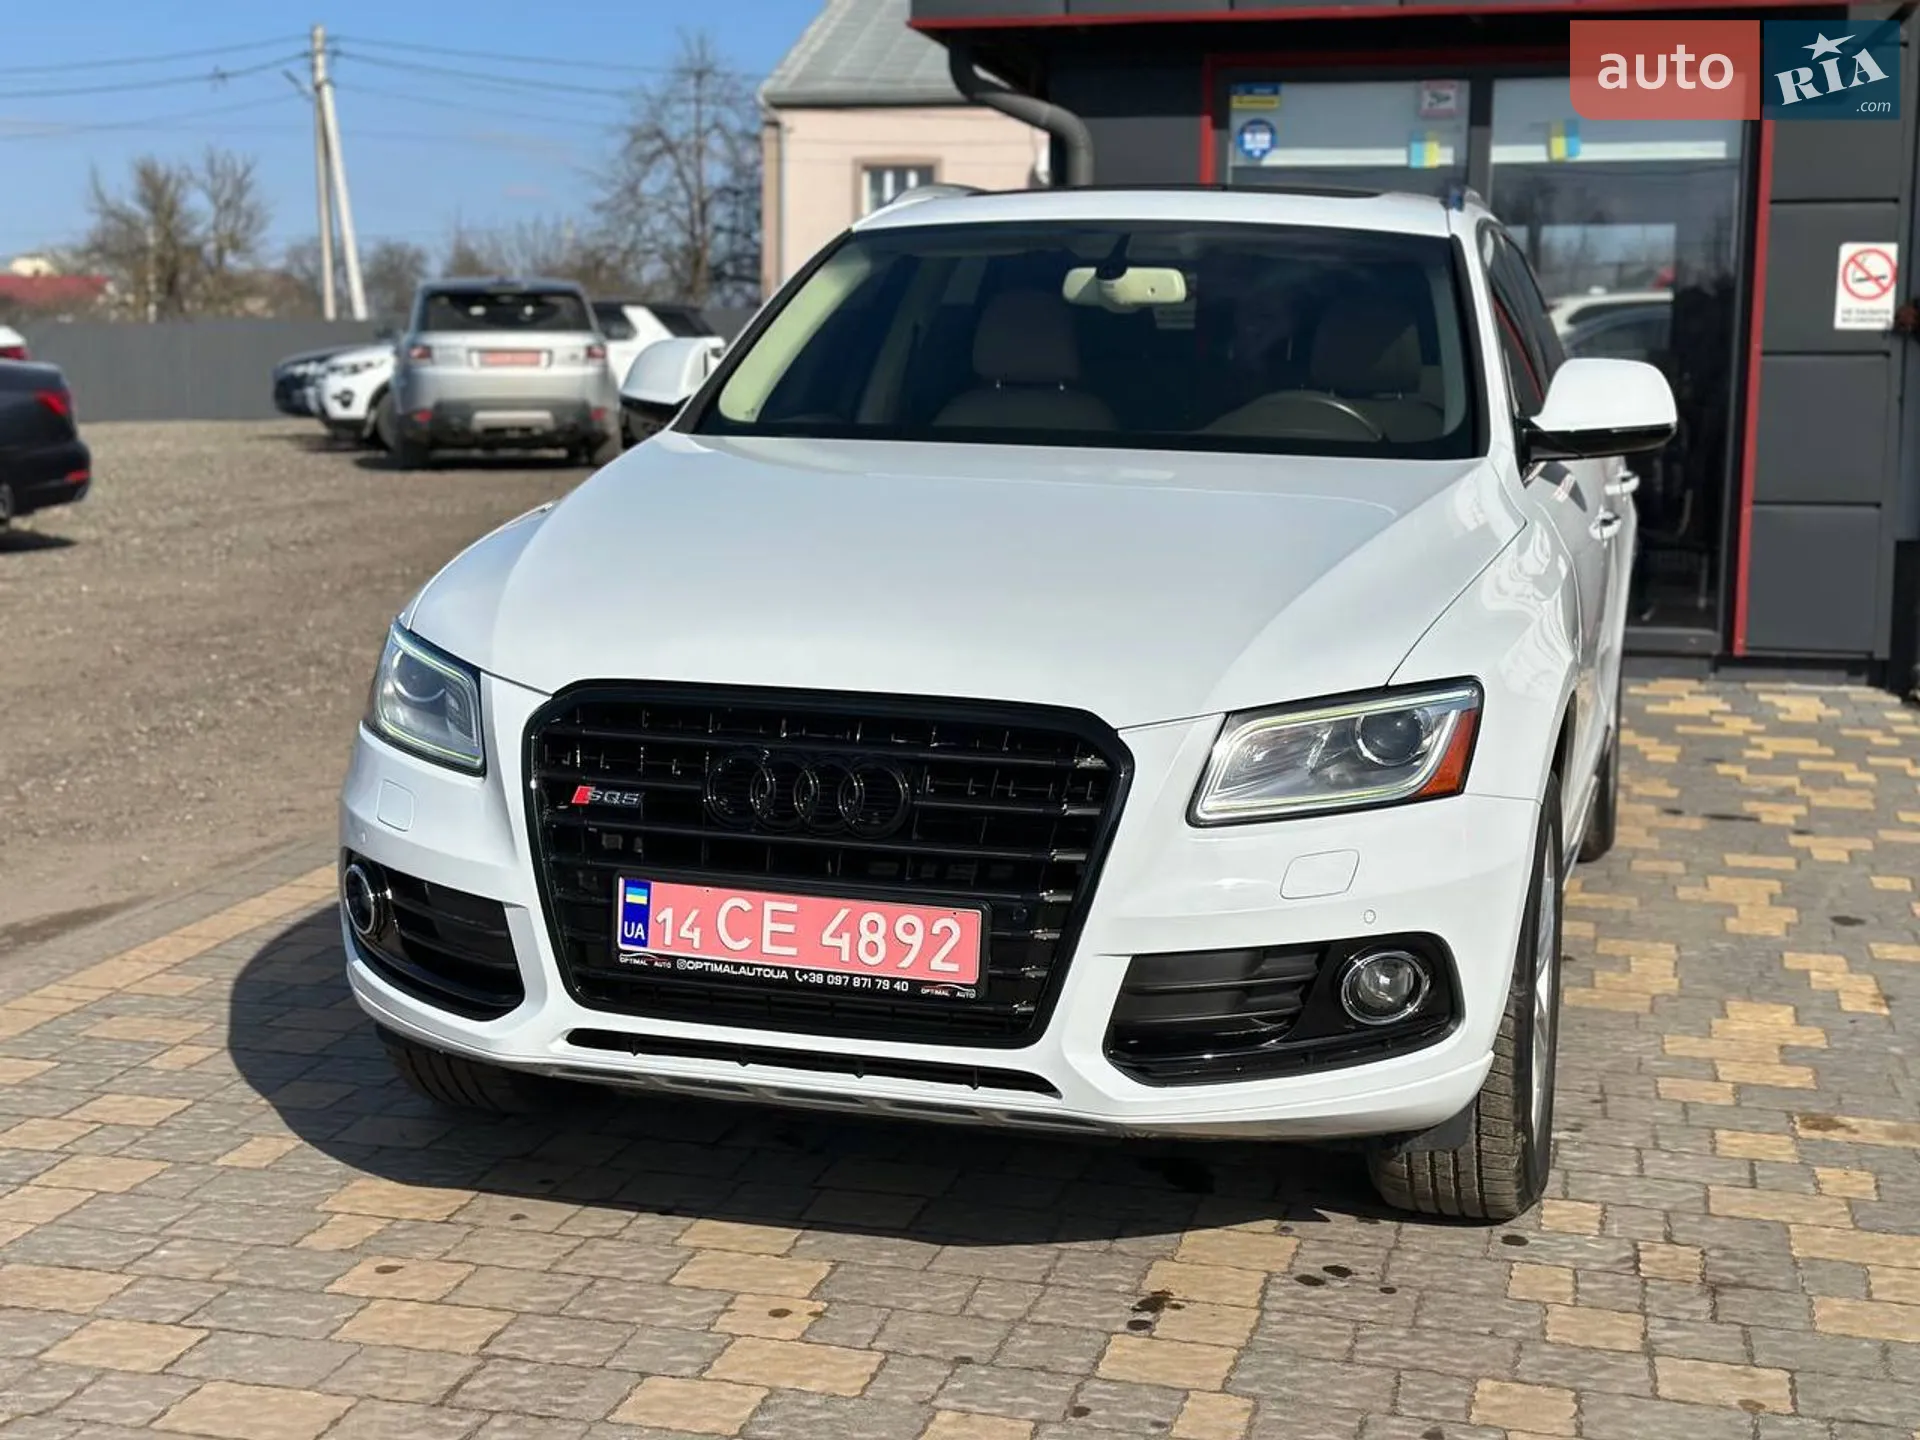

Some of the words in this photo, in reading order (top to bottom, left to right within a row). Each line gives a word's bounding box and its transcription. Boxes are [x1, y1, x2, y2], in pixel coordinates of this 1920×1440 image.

[624, 920, 645, 941] UA
[655, 906, 701, 949] 14
[716, 897, 798, 956] CE
[820, 907, 961, 973] 4892
[619, 957, 648, 966] OPTIMAL
[653, 960, 671, 969] AUTO
[802, 972, 823, 984] +38
[826, 974, 849, 986] 097
[852, 977, 872, 989] 871
[876, 979, 890, 990] 79
[893, 981, 909, 992] 40
[920, 987, 950, 997] OPTIMAL
[956, 990, 976, 999] AUTO
